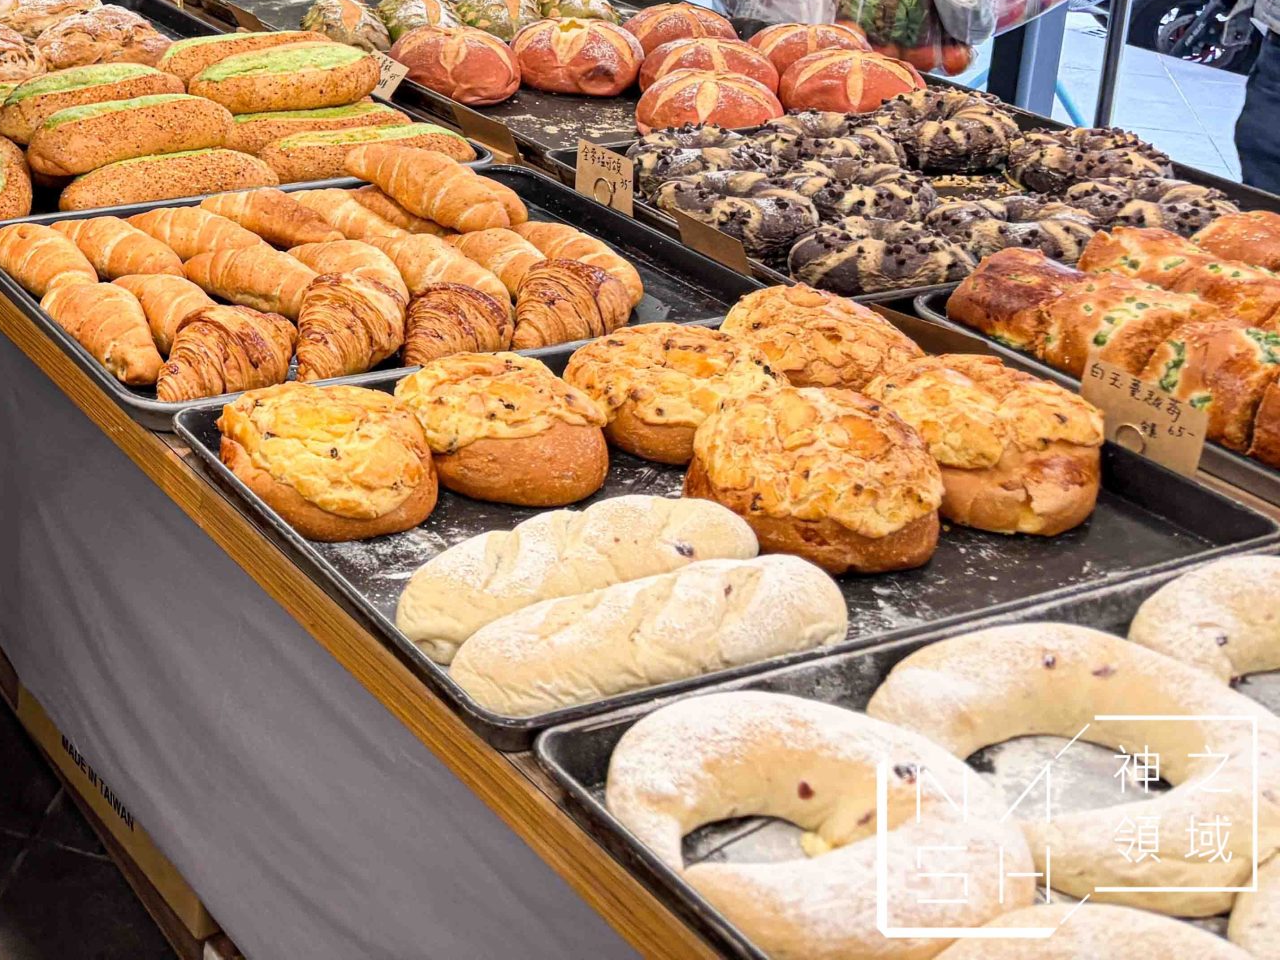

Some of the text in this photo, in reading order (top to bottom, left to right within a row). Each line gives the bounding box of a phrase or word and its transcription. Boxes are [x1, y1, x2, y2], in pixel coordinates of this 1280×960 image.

[61, 735, 135, 832] MADE IN TAIWAN
